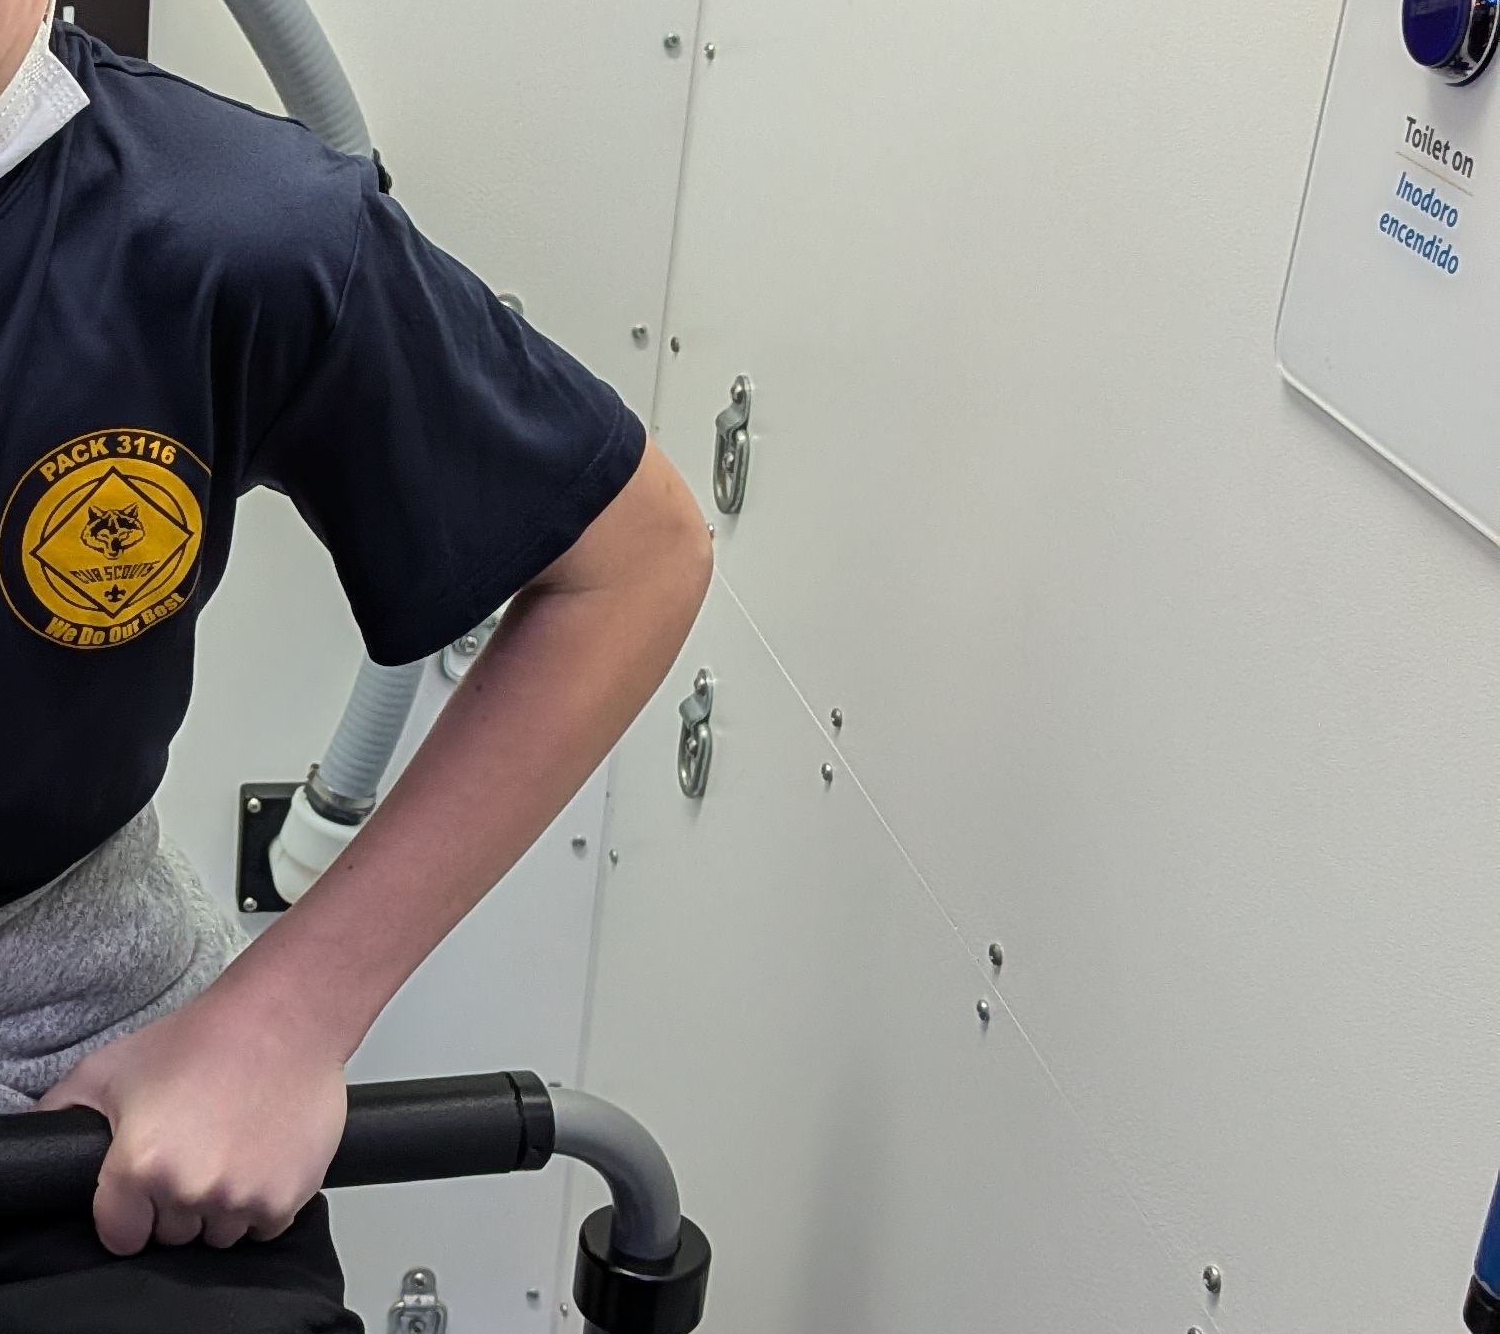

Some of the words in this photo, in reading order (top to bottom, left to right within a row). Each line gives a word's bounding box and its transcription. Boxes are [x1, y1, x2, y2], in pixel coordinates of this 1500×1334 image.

[1404, 115, 1451, 165] Toilet
[1451, 150, 1474, 179] on
[1395, 171, 1459, 228] Inodoro
[1379, 212, 1460, 275] encendido
[39, 436, 109, 482] PACK
[116, 435, 177, 464] 3116
[45, 616, 77, 643] We
[77, 628, 105, 645] Do
[109, 619, 140, 644] Our
